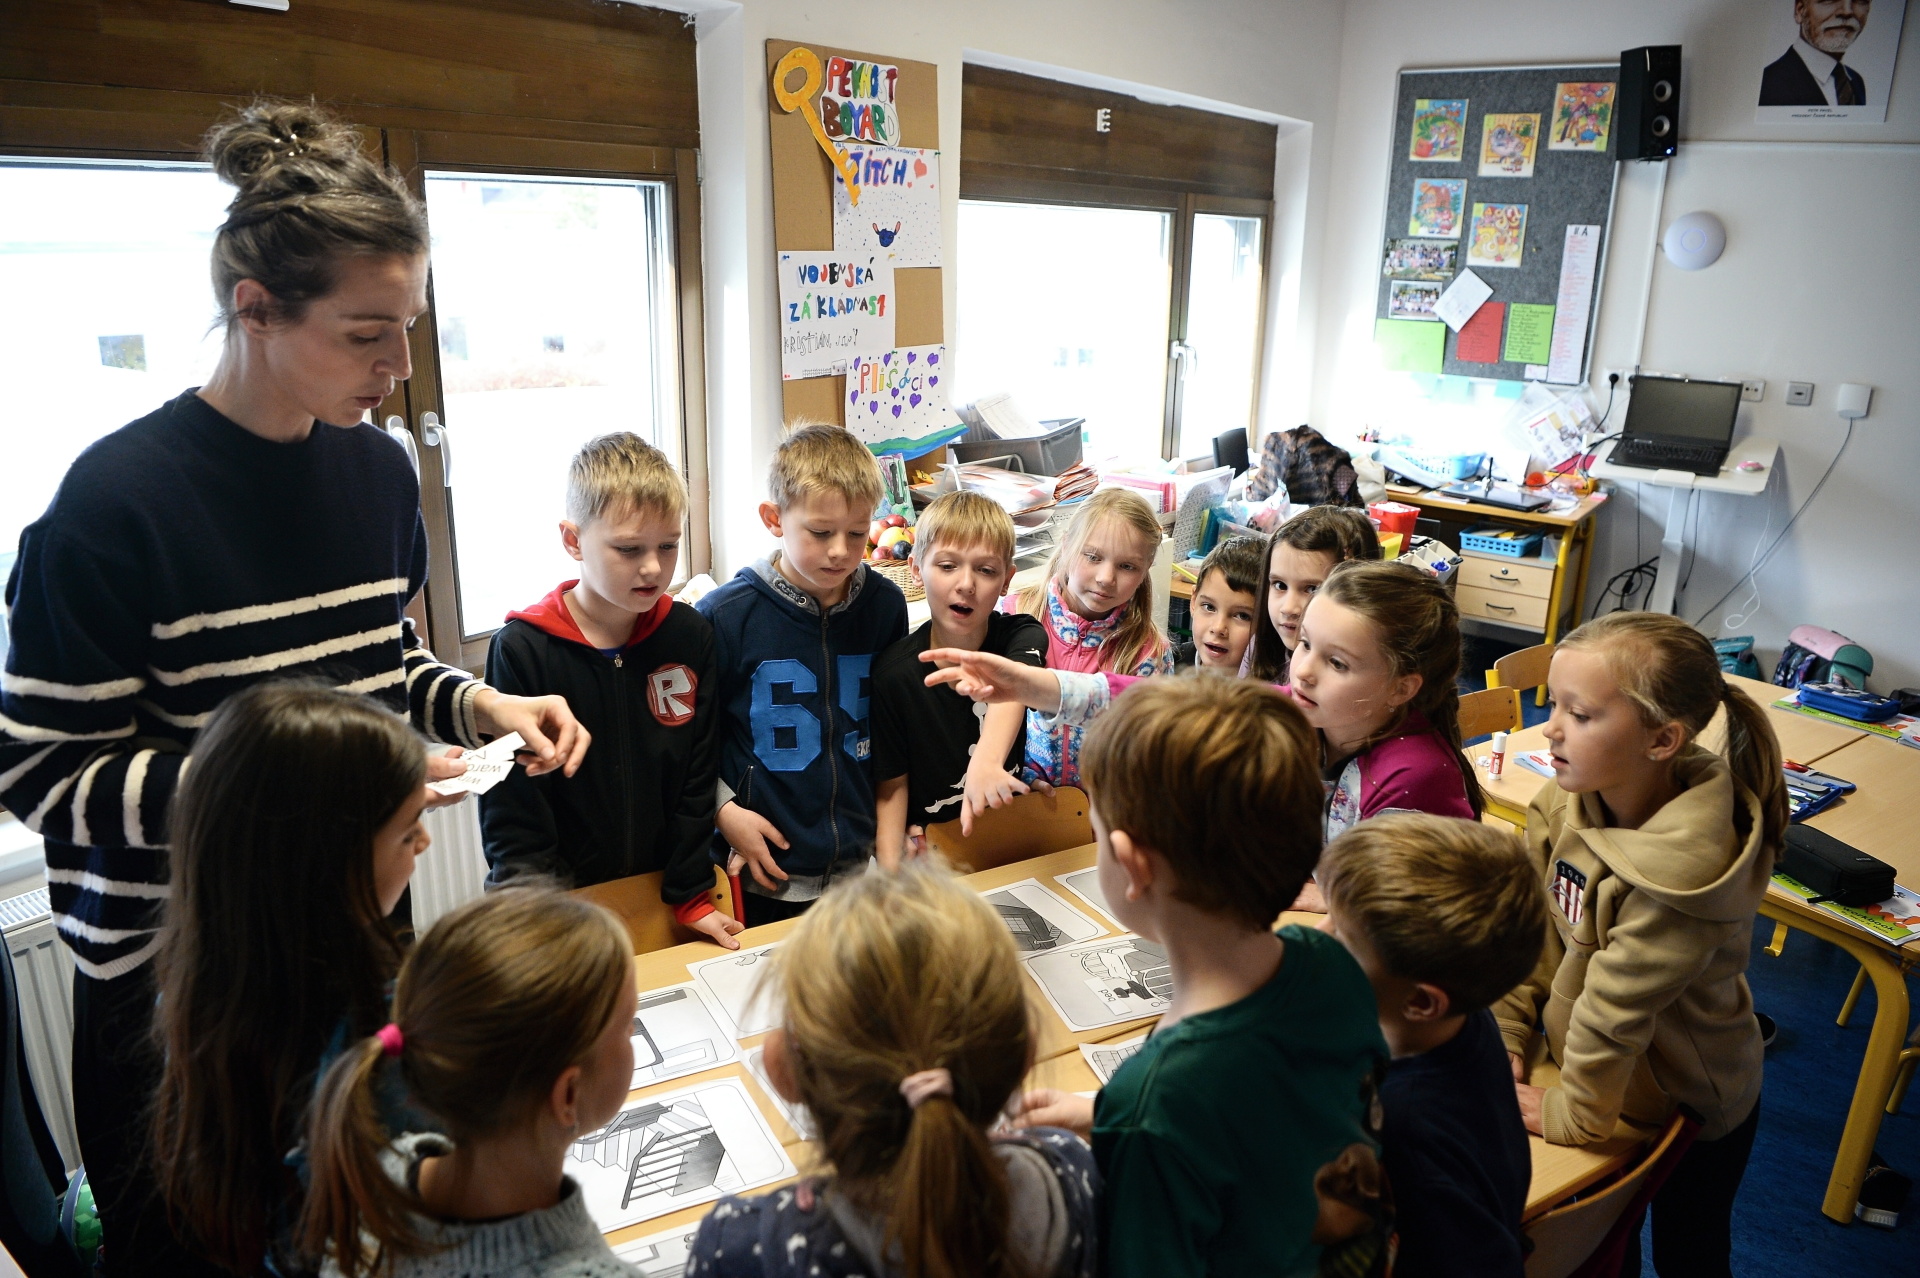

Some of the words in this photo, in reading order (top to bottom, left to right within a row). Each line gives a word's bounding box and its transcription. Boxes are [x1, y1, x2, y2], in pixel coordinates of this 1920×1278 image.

[822, 96, 900, 146] BOYARD
[799, 257, 875, 288] VOJENSKÁ
[649, 665, 695, 720] R
[1781, 876, 1798, 887] The
[1843, 906, 1895, 932] workbook
[1098, 988, 1116, 1003] bed
